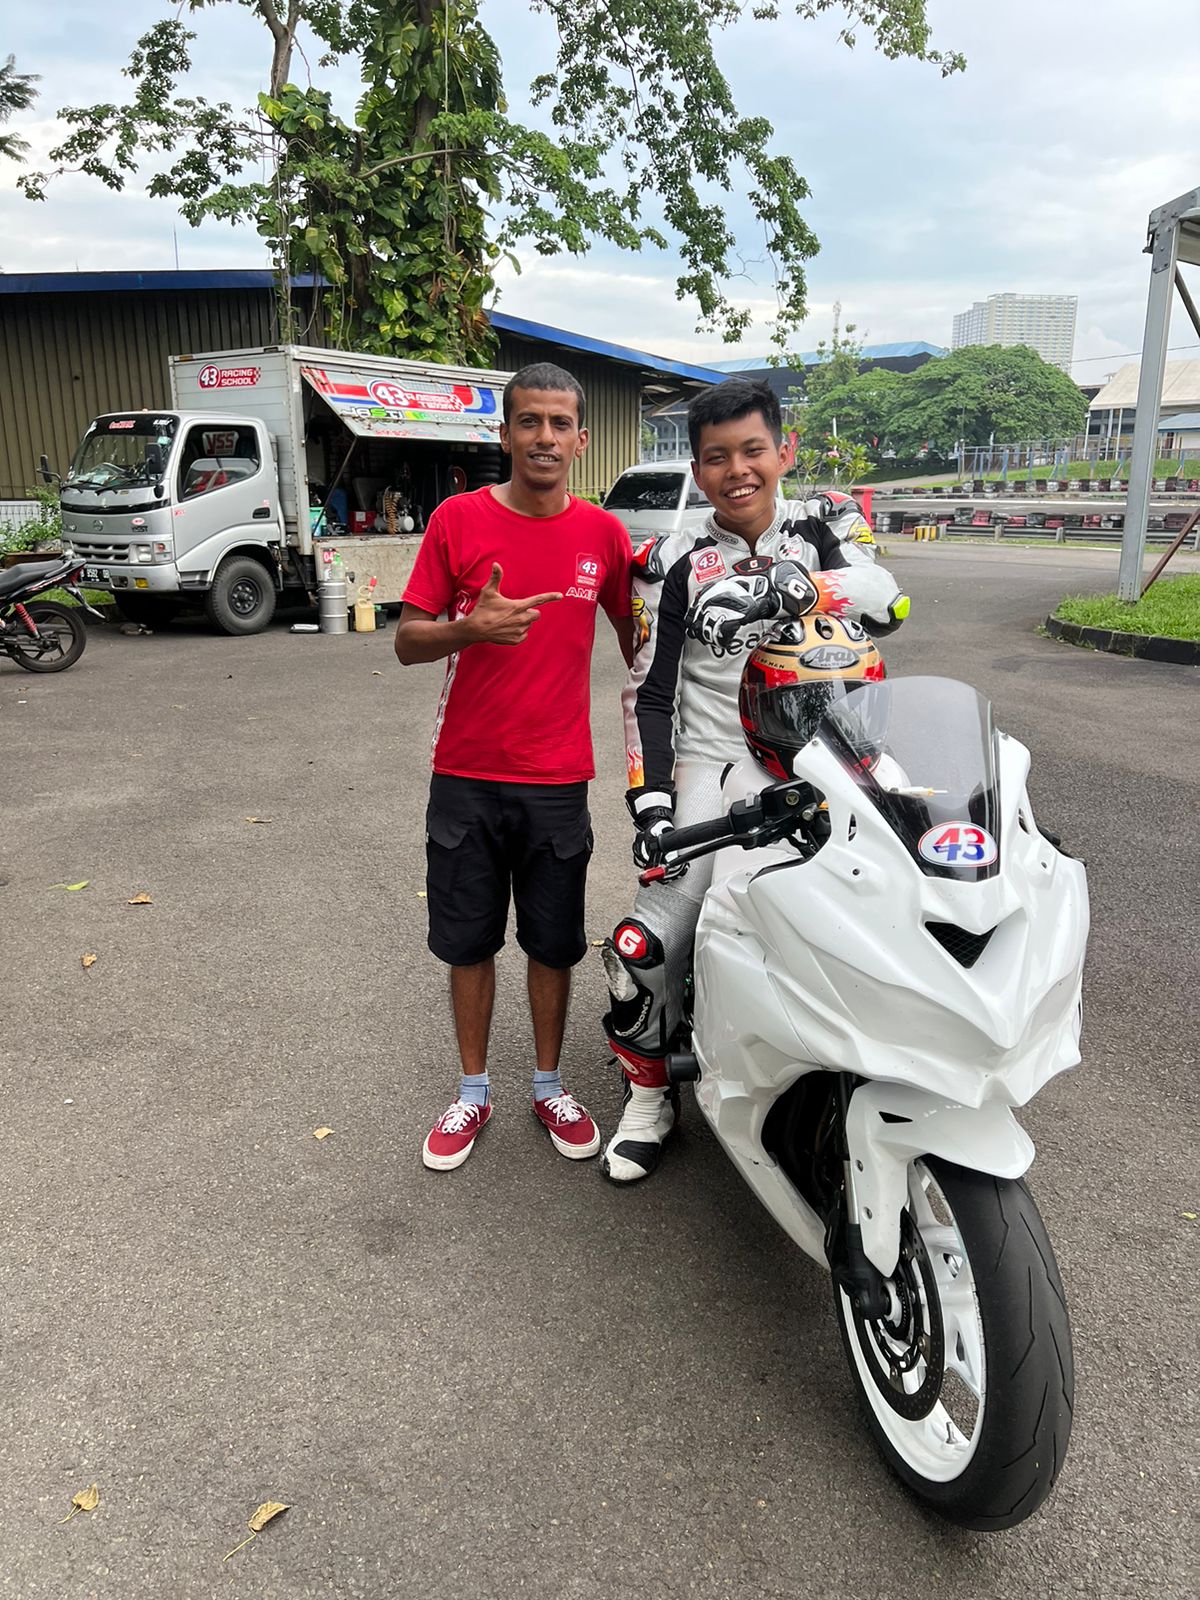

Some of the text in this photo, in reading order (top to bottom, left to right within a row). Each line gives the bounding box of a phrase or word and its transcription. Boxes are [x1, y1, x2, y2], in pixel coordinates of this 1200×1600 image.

[200, 367, 254, 386] 43 RACING
[221, 377, 254, 386] SCHOOL
[375, 385, 410, 406] 43
[581, 561, 598, 576] 43
[698, 553, 718, 569] 43
[787, 578, 808, 600] G
[812, 646, 854, 663] Arai
[932, 827, 987, 862] 43
[618, 929, 643, 956] G
